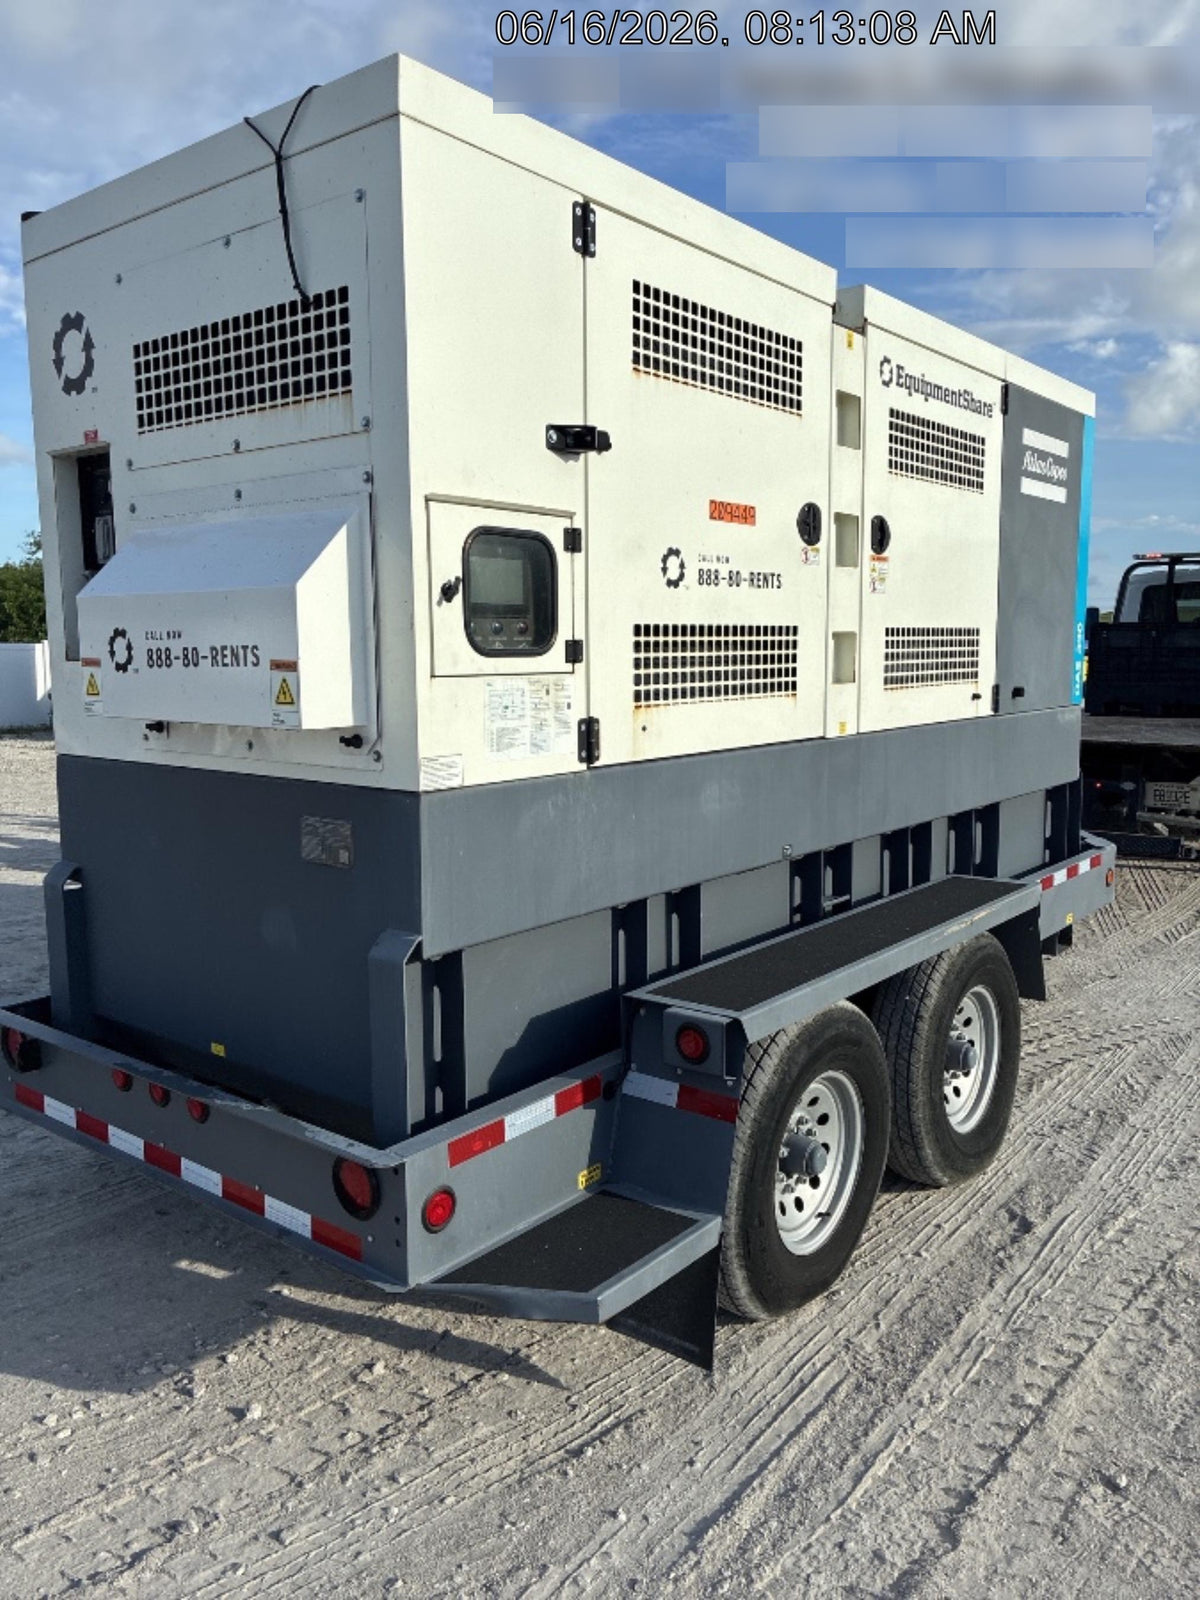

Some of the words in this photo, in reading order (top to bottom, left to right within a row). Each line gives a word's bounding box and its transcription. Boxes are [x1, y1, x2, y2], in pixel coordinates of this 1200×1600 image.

[895, 363, 994, 418] EquipmentShare
[697, 568, 783, 590] 888-80-RENTS
[146, 645, 261, 669] 888-80-RENTS
